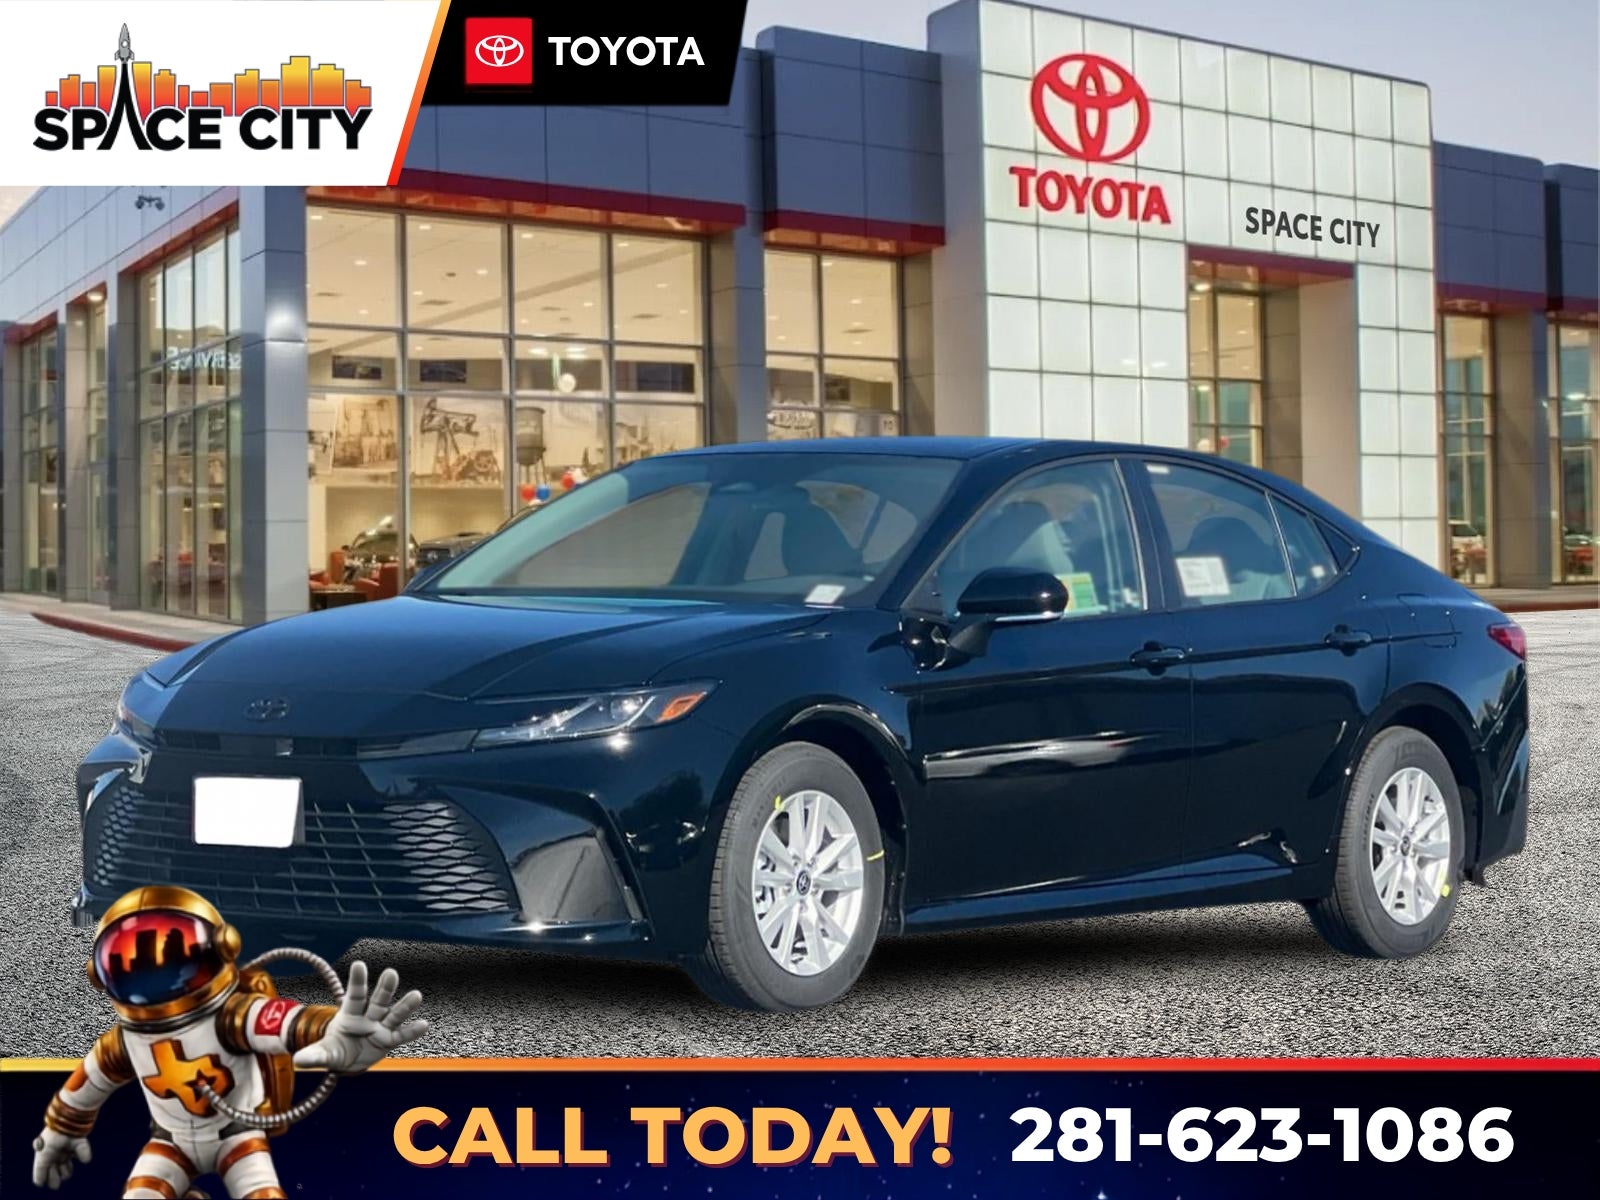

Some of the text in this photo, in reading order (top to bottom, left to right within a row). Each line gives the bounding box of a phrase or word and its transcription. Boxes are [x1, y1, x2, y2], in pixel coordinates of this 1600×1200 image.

[1009, 166, 1171, 225] TOYOTA
[1245, 206, 1381, 249] SPACE CITY
